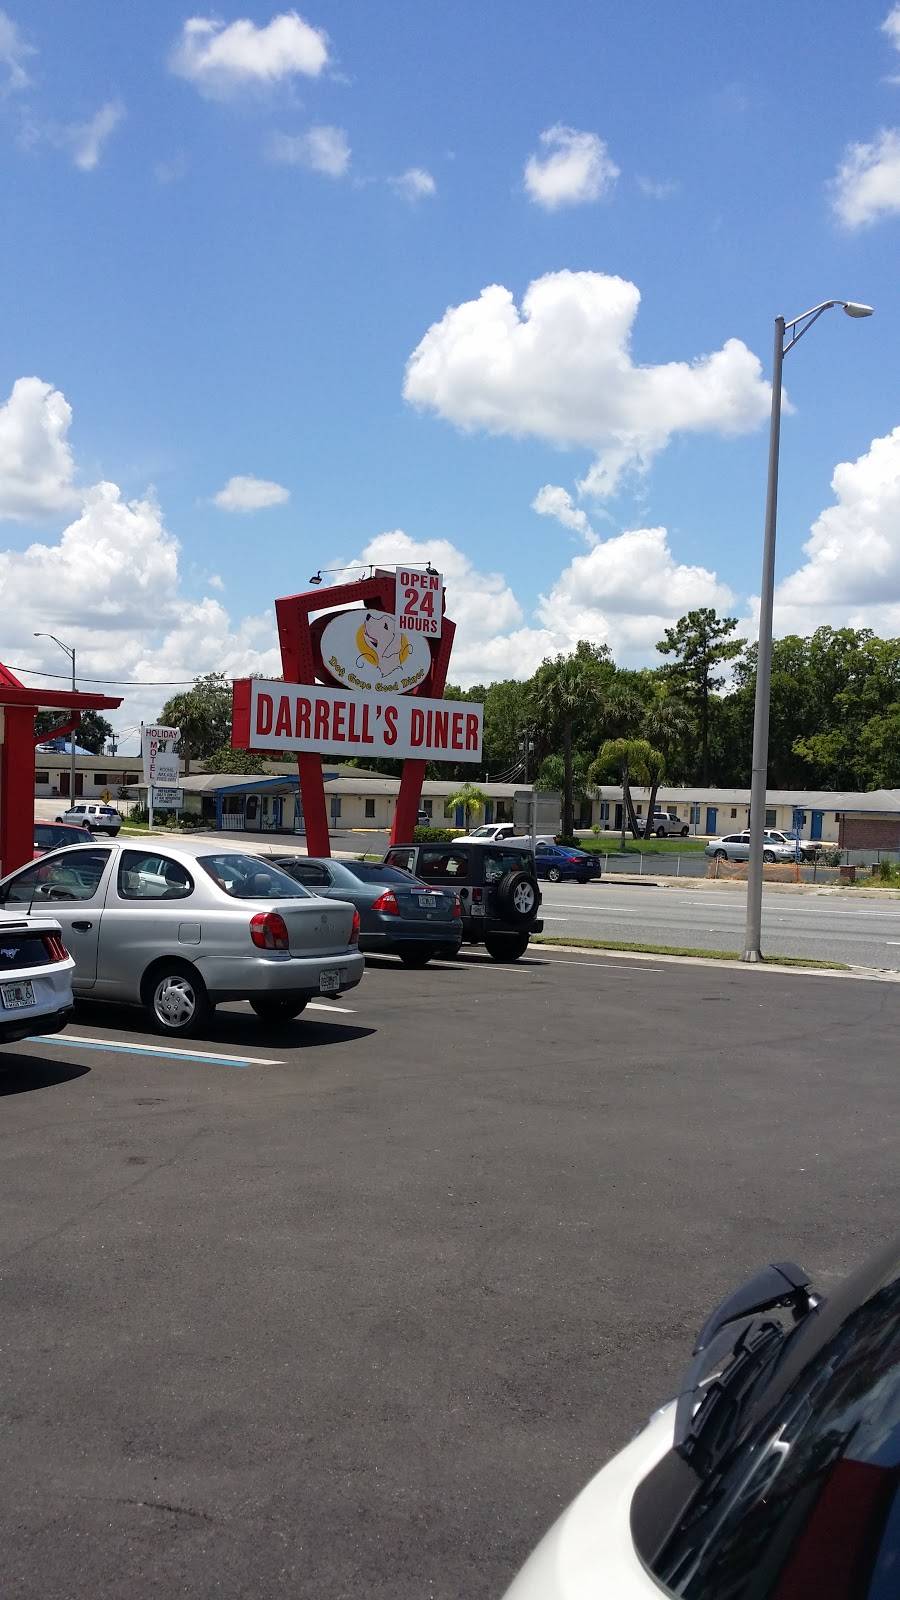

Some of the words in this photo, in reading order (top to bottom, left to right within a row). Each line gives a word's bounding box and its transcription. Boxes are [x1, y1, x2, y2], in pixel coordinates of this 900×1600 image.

[400, 571, 440, 591] OPEN
[403, 589, 435, 618] 24
[399, 615, 438, 634] HOURS
[145, 729, 178, 739] HOLIDAY
[256, 693, 398, 746] DARRELL'S
[410, 708, 480, 751] DINER
[149, 742, 158, 779] MOTEL
